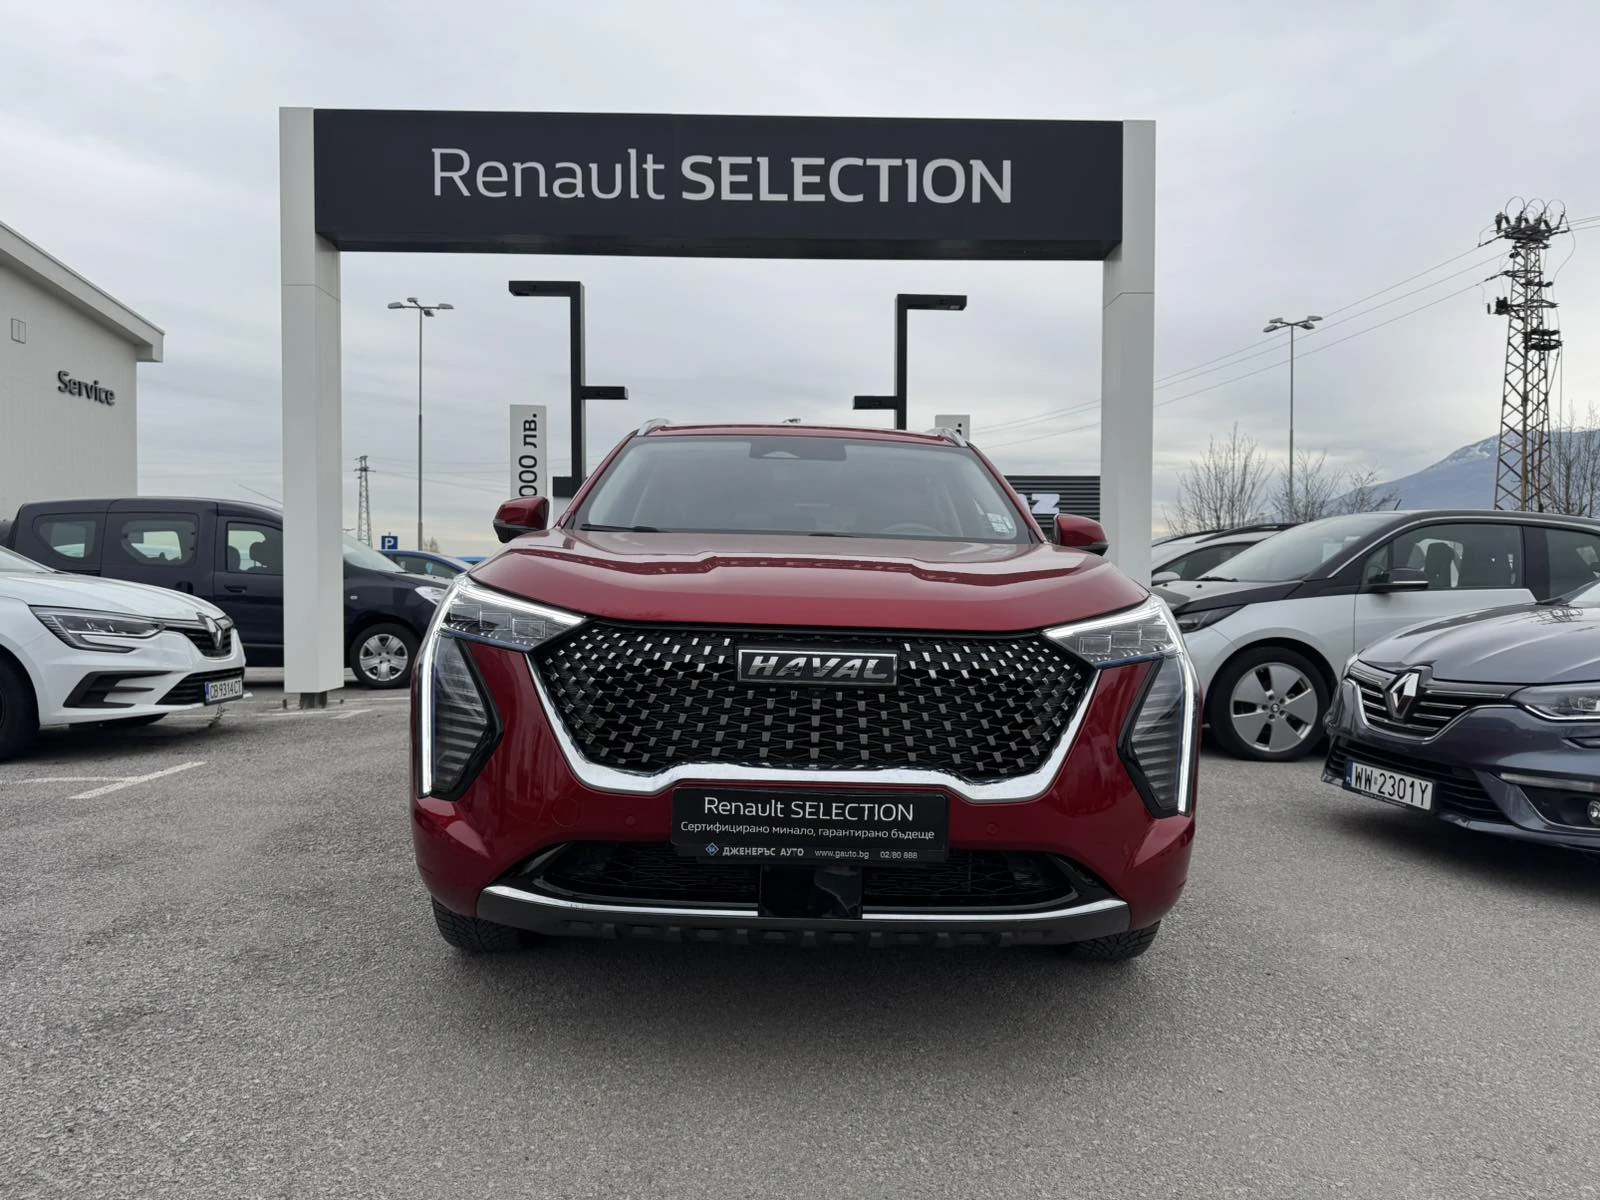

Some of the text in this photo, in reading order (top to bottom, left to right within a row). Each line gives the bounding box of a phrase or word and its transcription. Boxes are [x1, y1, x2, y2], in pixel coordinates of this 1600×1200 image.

[431, 147, 1013, 204] Renault SELECTION
[57, 370, 115, 407] Service
[384, 537, 395, 550] P
[748, 655, 888, 679] HAVAL
[1355, 765, 1373, 791] WW
[1378, 773, 1428, 806] 2301Y
[704, 796, 914, 822] Renault SELECTION
[680, 821, 935, 840] Сертифицирано минало, гарантирано бъдеще
[722, 846, 776, 857] ДЖЕНЕРЪС
[779, 847, 805, 857] АУТО
[814, 849, 870, 860] www.gauto.bg
